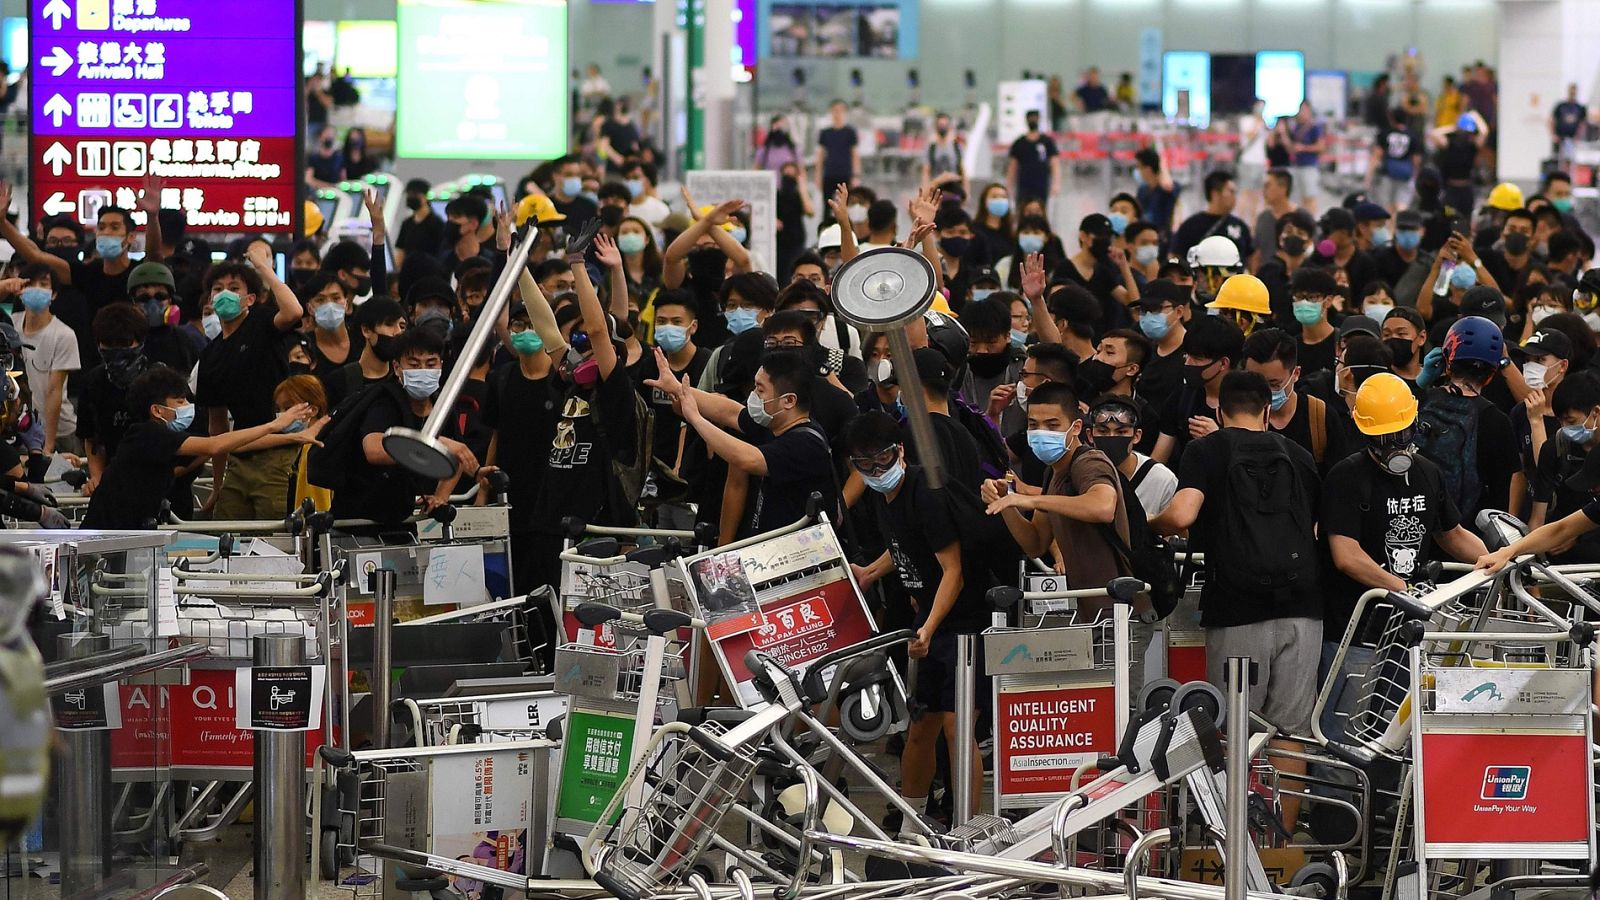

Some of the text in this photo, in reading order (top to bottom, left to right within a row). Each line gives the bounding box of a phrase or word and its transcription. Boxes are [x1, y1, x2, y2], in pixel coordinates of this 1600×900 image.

[135, 63, 164, 79] Hall
[186, 209, 240, 226] Service
[761, 621, 824, 645] MA PAK LEUNG
[1009, 699, 1096, 716] INTELLIGENT
[1009, 717, 1068, 733] QUALITY
[585, 737, 622, 757] 用微信支付
[1009, 733, 1093, 749] ASSURANCE
[1487, 774, 1526, 787] UnionPay
[1473, 804, 1537, 814] UnionPay Your Way
